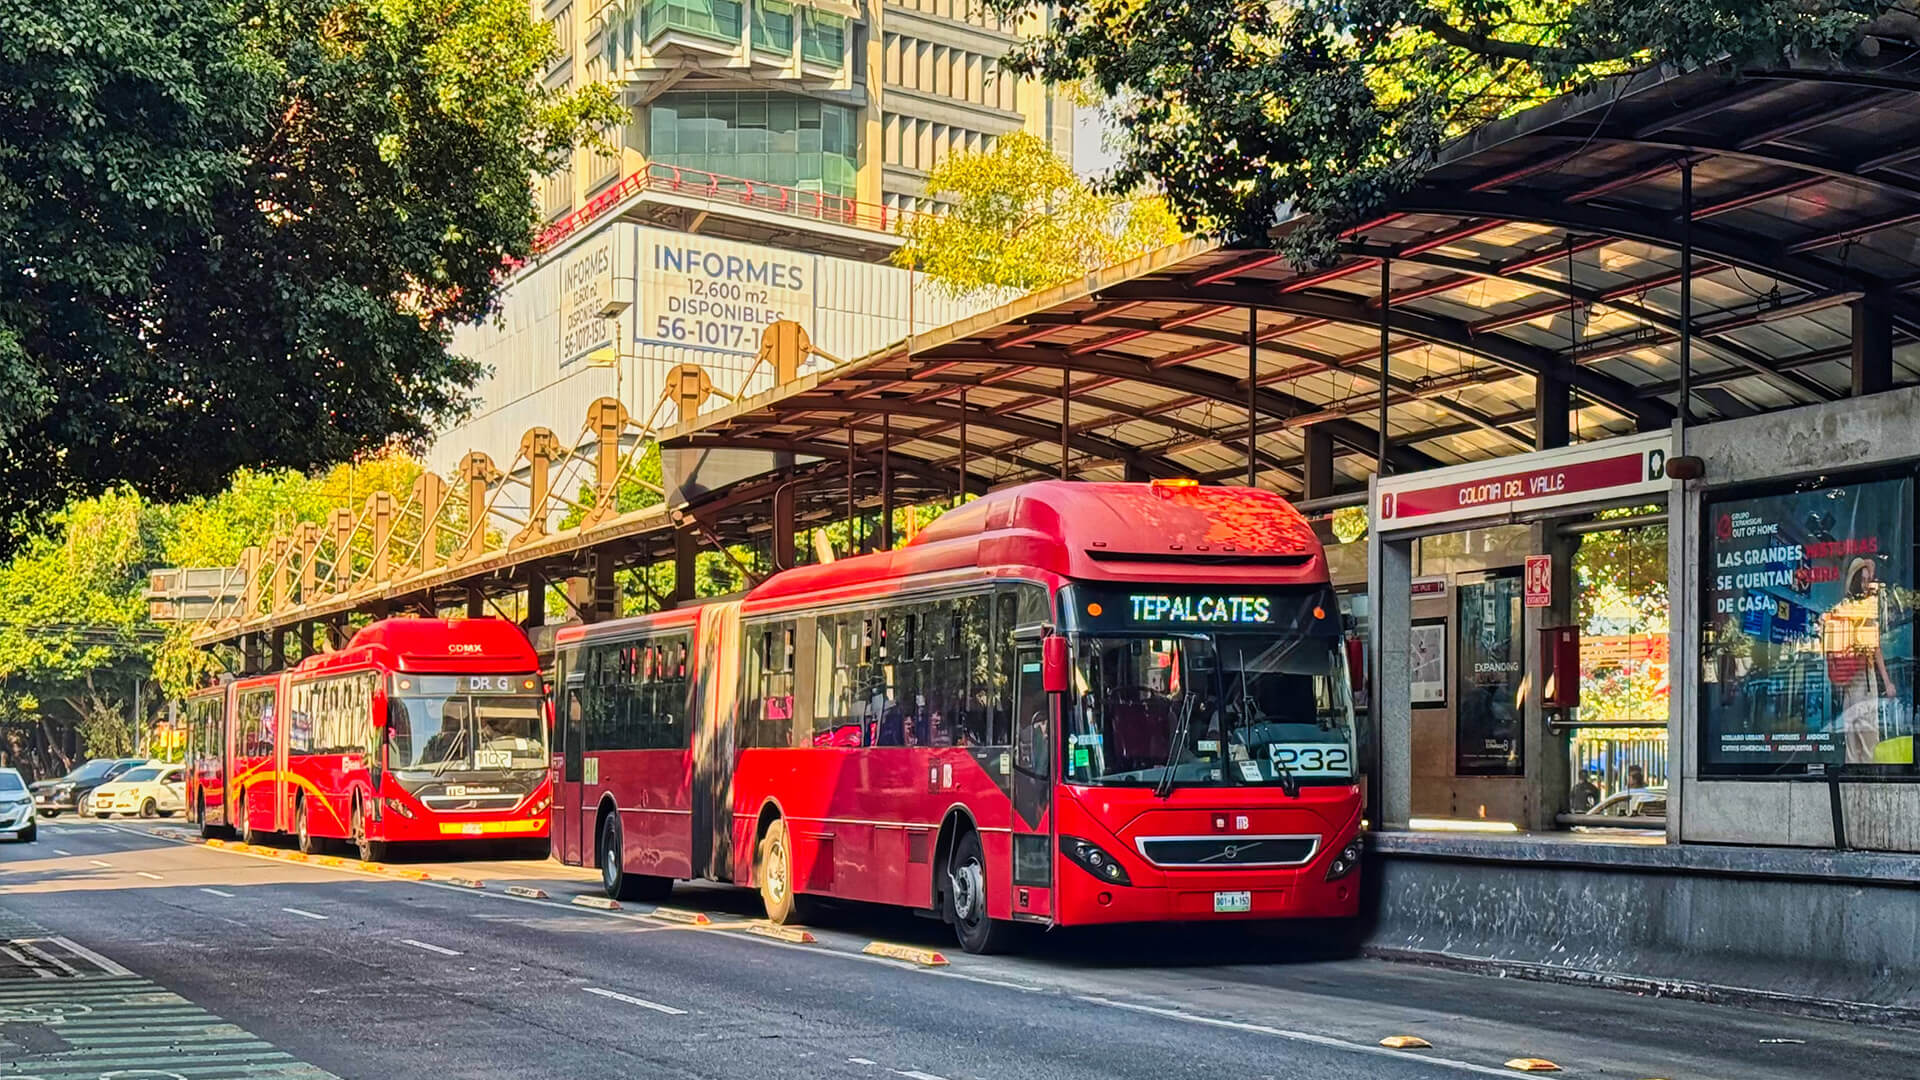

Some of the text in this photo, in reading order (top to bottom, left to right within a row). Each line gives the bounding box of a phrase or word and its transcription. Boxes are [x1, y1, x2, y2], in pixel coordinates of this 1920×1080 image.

[565, 245, 608, 294] INFORMES
[655, 244, 803, 290] INFORMES
[688, 278, 768, 305] 12,600 m2
[669, 296, 784, 325] DISPONIBLES
[1459, 473, 1565, 504] COLONIA DEL VALLE
[1732, 523, 1778, 538] OUT OF HOME
[1717, 552, 1743, 568] LAS
[1745, 545, 1803, 565] GRANDES
[1717, 574, 1732, 591] SE
[1736, 569, 1793, 588] CUENTAN
[1130, 595, 1270, 622] TEPALCATES
[1717, 598, 1733, 613] DE
[448, 644, 482, 653] CDMX
[1474, 662, 1519, 672] EXPANDING
[497, 677, 508, 690] G
[1273, 749, 1349, 771] 232
